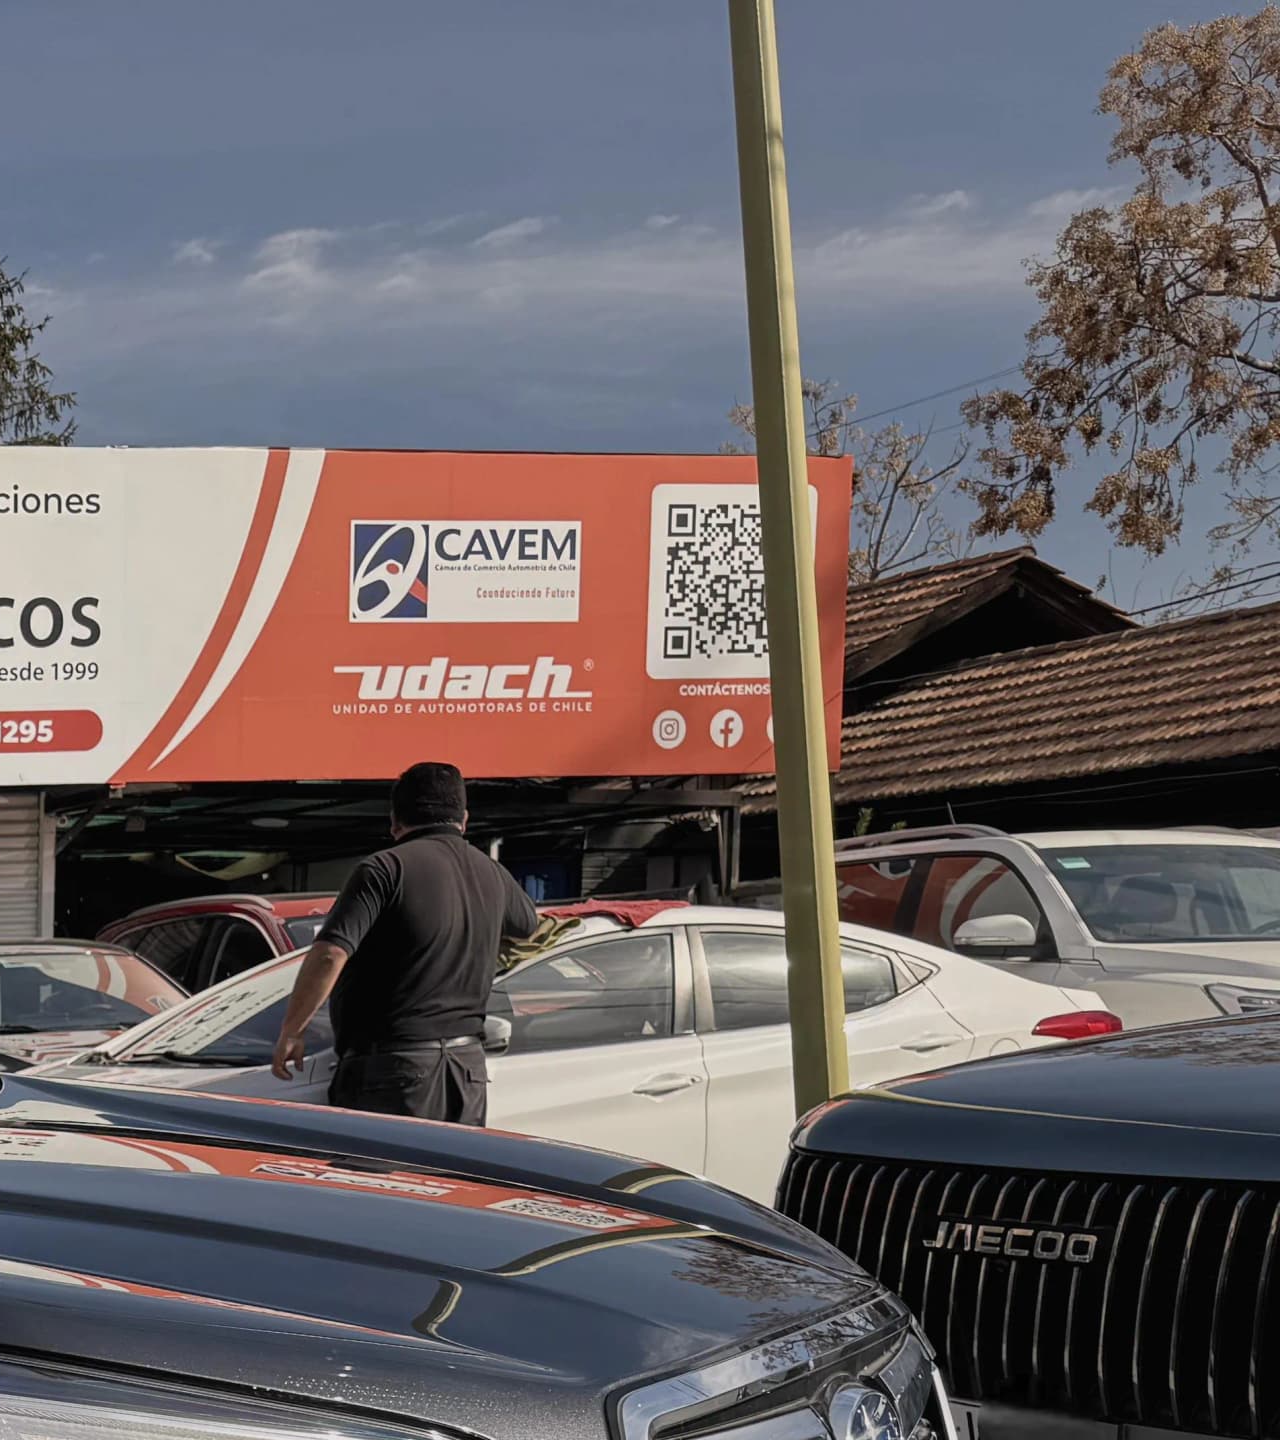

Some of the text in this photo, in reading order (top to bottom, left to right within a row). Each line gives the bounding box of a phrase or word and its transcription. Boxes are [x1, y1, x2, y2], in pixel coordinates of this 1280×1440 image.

[434, 528, 577, 561] CAVEM
[462, 563, 472, 572] de
[473, 563, 506, 572] Comercio
[507, 562, 547, 572] Automotriz
[548, 563, 557, 571] de
[558, 562, 576, 572] Chile
[51, 662, 100, 682] 1999
[332, 656, 593, 700] udach
[679, 682, 772, 696] CONTÁCTENOS
[332, 701, 593, 715] UNIDAD DE AUTOMOTORAS DE CHILE
